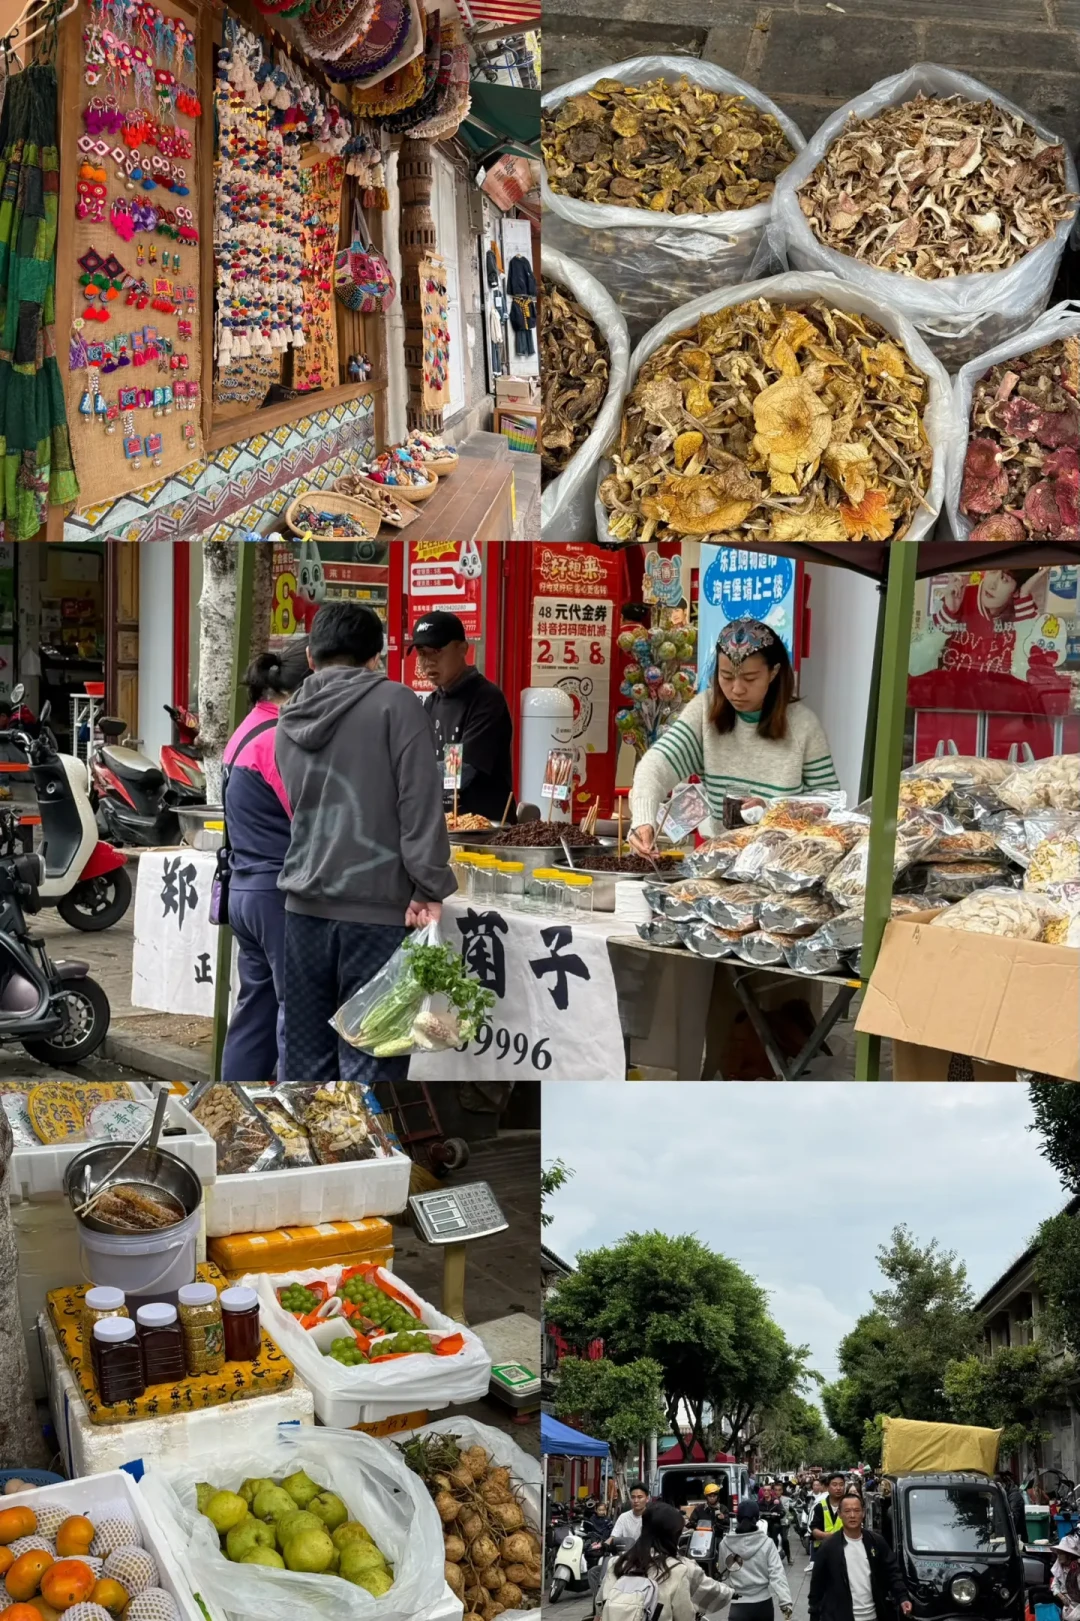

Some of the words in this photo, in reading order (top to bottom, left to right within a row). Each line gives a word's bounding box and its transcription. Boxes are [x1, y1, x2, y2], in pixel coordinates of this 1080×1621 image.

[551, 557, 600, 580] 好想来
[713, 574, 783, 604] 淘气堡请上二楼
[538, 606, 552, 618] 48
[555, 603, 607, 621] 元代金券
[537, 621, 607, 637] 抖音扫码随机减
[161, 855, 199, 932] 郑
[194, 952, 214, 985] 正
[455, 907, 591, 1011] 菌子
